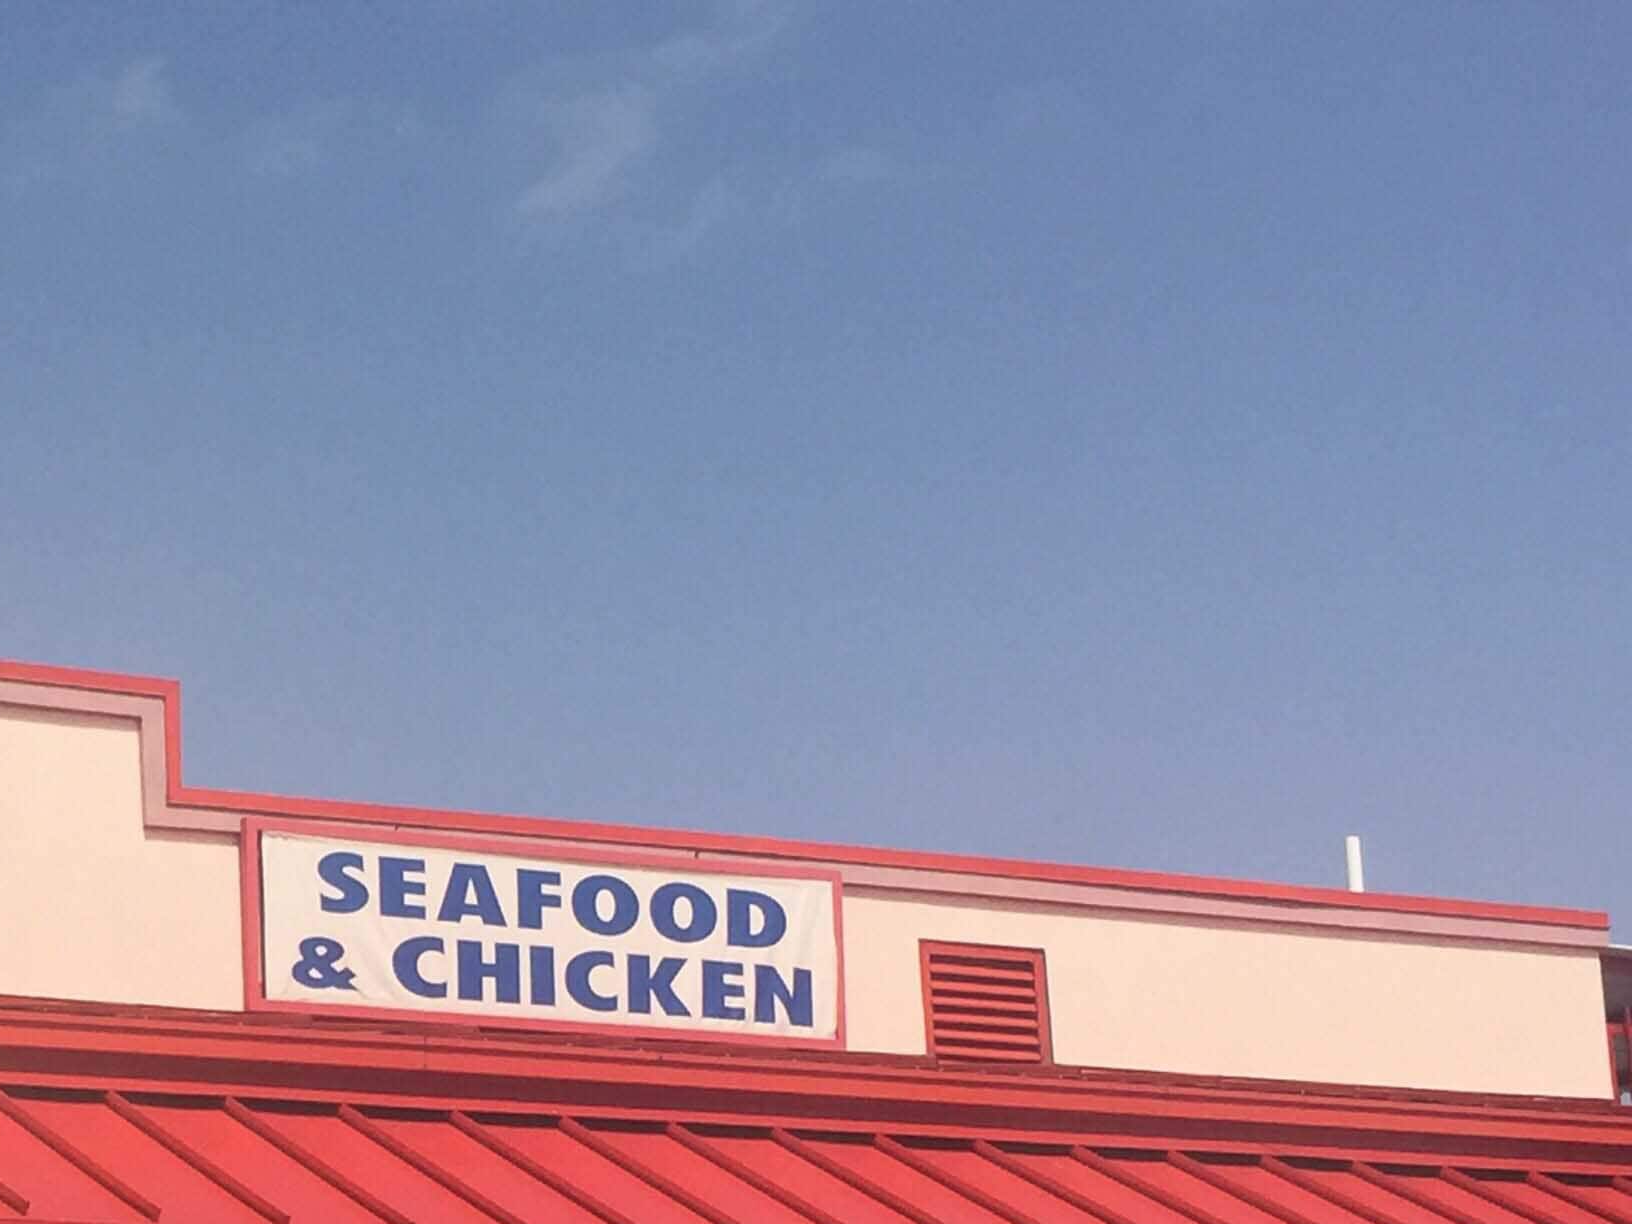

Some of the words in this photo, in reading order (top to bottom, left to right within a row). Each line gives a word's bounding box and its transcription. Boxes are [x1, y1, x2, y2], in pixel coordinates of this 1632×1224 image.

[317, 851, 787, 949] SEAFOOD
[290, 936, 356, 991] &
[391, 936, 814, 1028] CHICKEN
